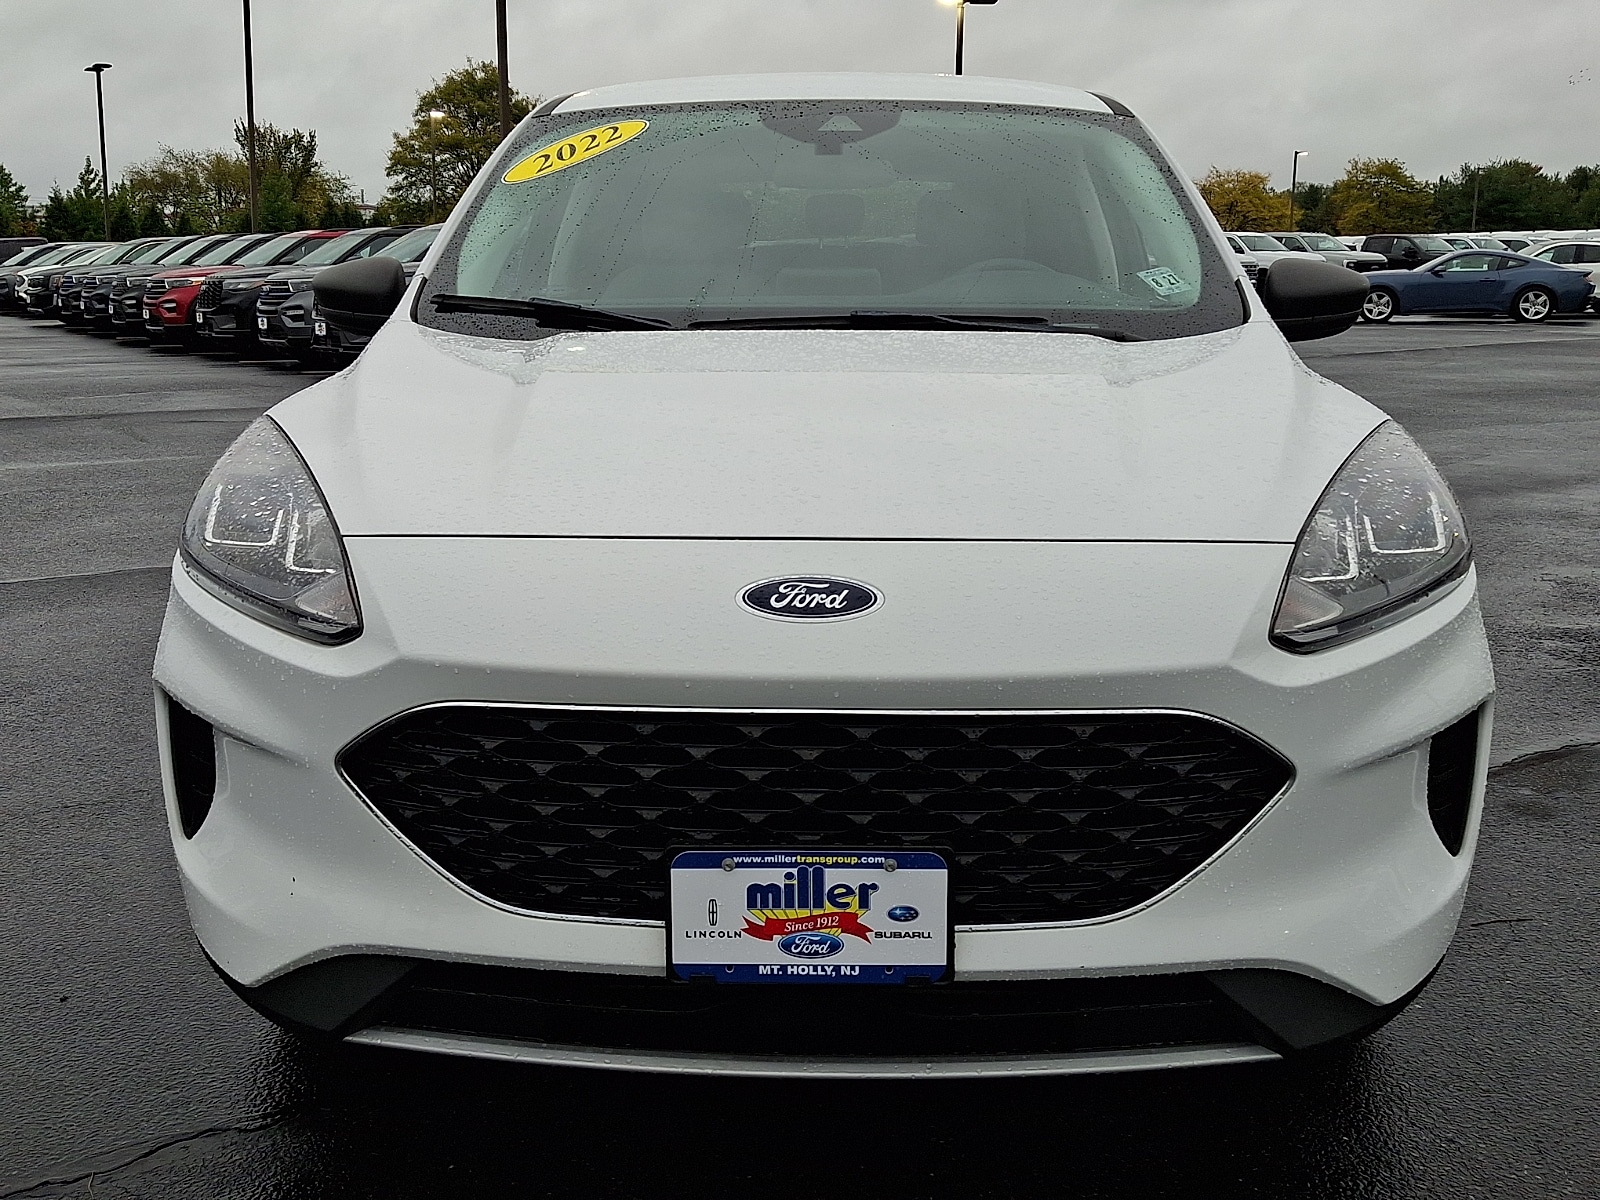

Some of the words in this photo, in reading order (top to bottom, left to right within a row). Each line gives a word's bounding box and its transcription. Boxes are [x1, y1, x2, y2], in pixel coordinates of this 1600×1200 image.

[533, 126, 622, 174] 2022
[1151, 278, 1163, 288] 8
[1162, 274, 1180, 286] 27
[770, 582, 849, 608] Ford
[733, 855, 885, 865] www.millertransgroup.com
[746, 866, 879, 910] miller
[784, 920, 814, 932] Since
[816, 915, 839, 928] 1912
[685, 930, 742, 939] LINCOLN
[874, 931, 932, 939] SUBARU
[791, 935, 830, 954] Ford
[758, 965, 782, 975] MT.
[787, 965, 836, 977] HOLLY,
[841, 965, 860, 975] NJ
